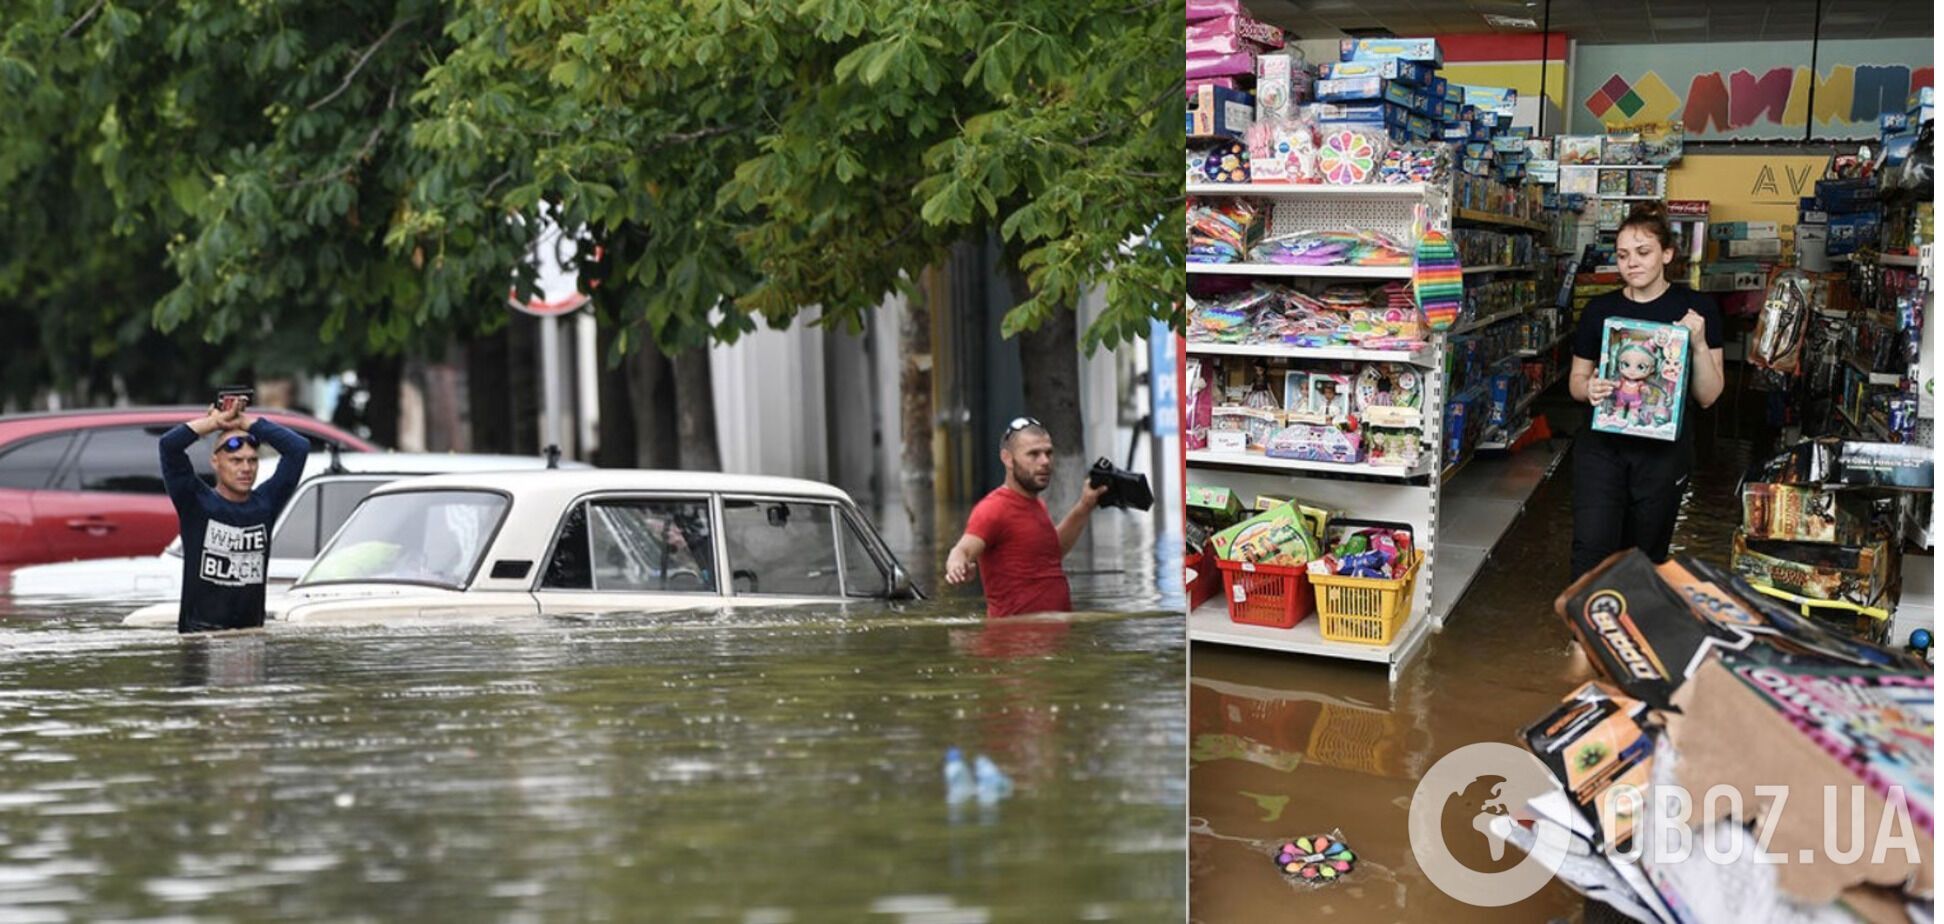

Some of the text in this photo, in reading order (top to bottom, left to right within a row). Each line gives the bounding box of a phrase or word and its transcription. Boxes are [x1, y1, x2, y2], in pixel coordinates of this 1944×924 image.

[1682, 64, 1934, 135] ЛИМП
[210, 526, 264, 551] WHITE
[204, 556, 261, 579] BLACK
